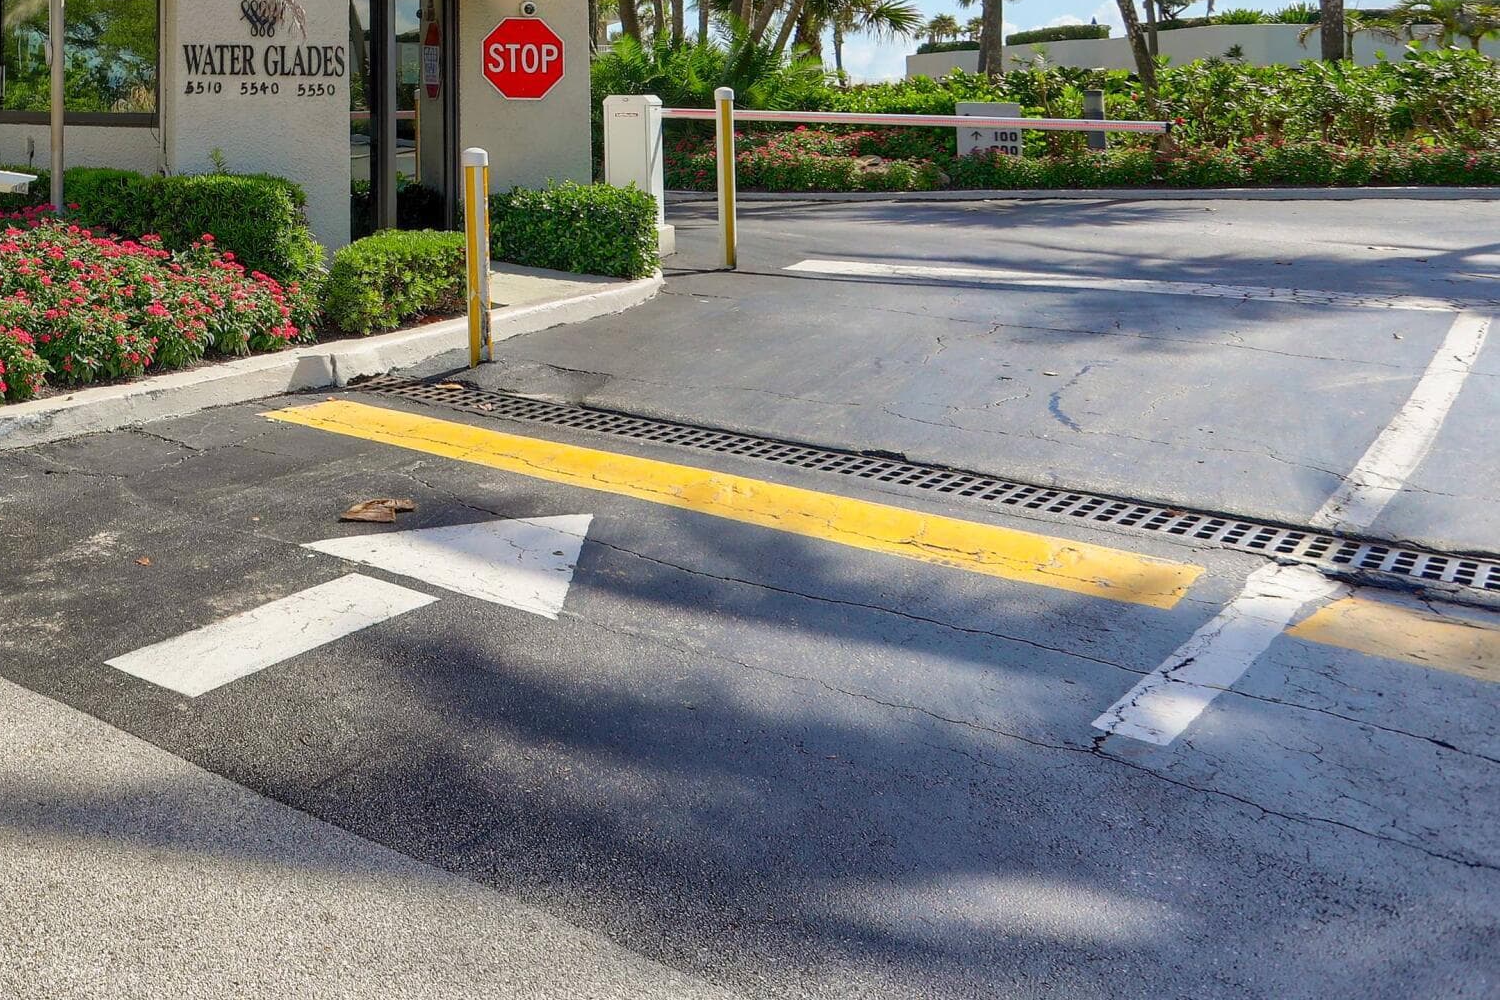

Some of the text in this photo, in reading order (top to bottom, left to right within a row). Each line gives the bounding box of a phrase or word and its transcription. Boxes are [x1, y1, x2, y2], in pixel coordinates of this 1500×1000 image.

[183, 44, 345, 77] WATER GLADES
[488, 43, 558, 74] STOP
[185, 81, 336, 97] 5510 5540 5550
[994, 131, 1018, 142] 100
